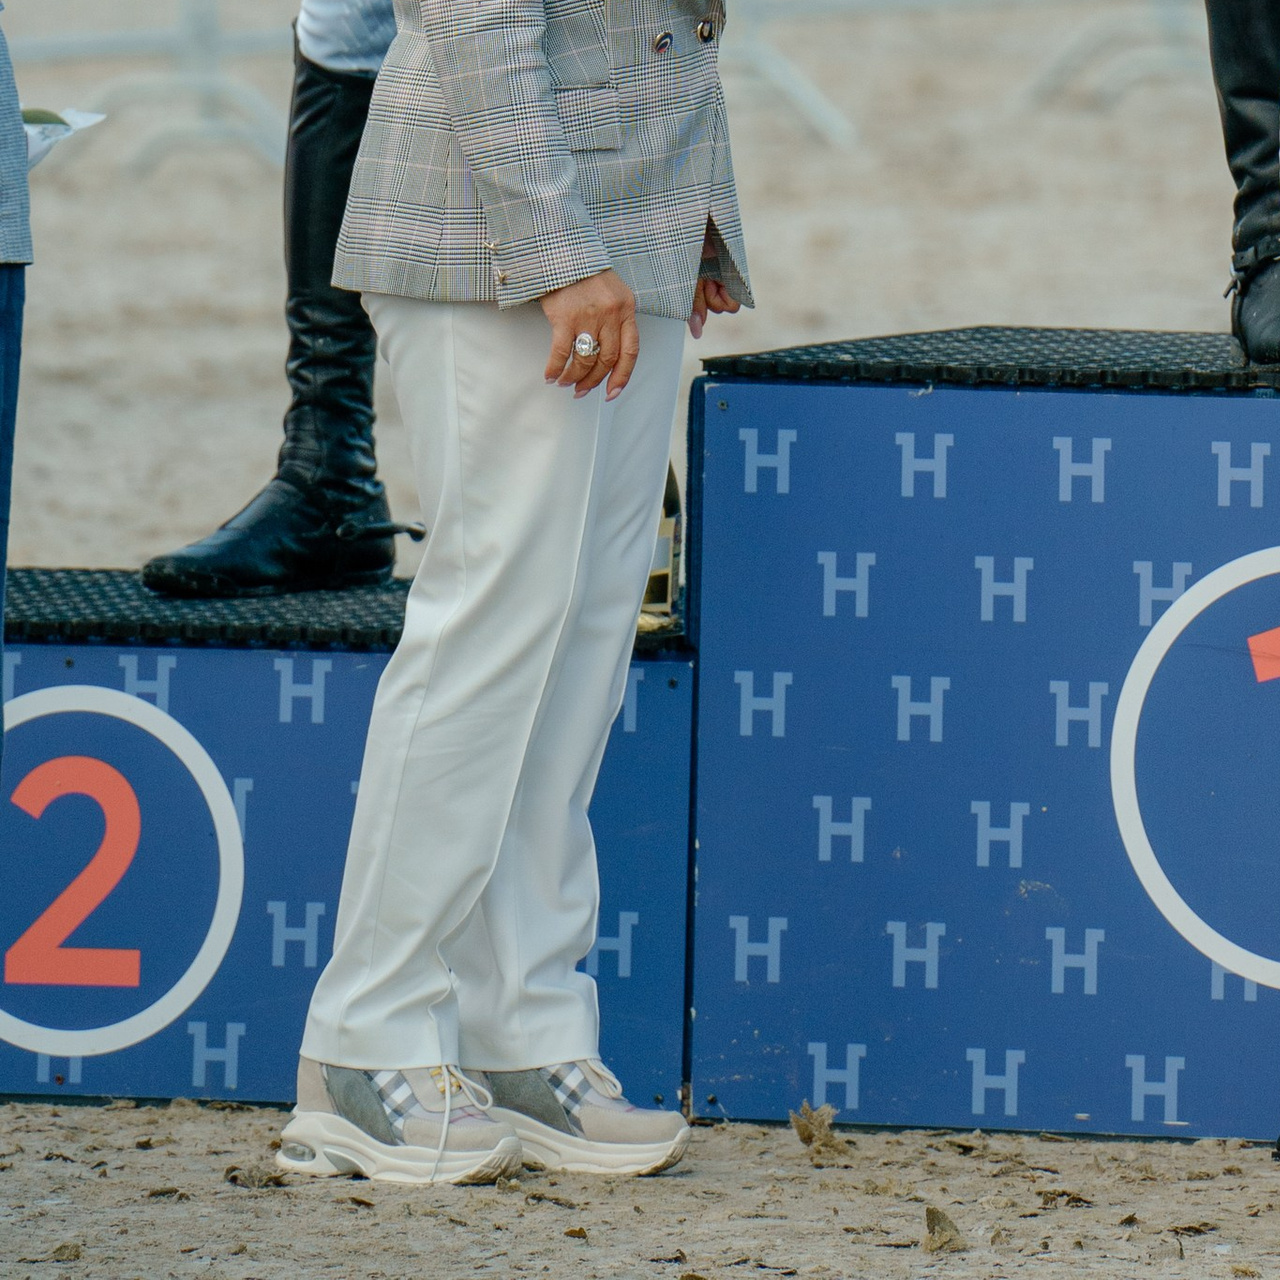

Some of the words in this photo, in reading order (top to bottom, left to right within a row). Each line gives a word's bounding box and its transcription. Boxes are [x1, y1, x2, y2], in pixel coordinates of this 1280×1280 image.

[739, 428, 797, 494] H
[894, 431, 955, 499] H
[1052, 435, 1113, 504] H
[1210, 440, 1272, 509] H
[817, 551, 877, 618] H
[974, 555, 1034, 623] H
[273, 658, 333, 724] H
[734, 671, 793, 737] H
[891, 675, 951, 743] H
[1049, 680, 1110, 748] H
[812, 795, 872, 863] H
[970, 800, 1031, 869] H
[4, 755, 142, 987] 2
[266, 901, 326, 967] H
[729, 915, 788, 983] H
[886, 921, 946, 989] H
[1045, 926, 1106, 996] H
[188, 1022, 246, 1089] H
[807, 1042, 867, 1109] H
[966, 1048, 1026, 1116] H
[1124, 1054, 1186, 1125] H
